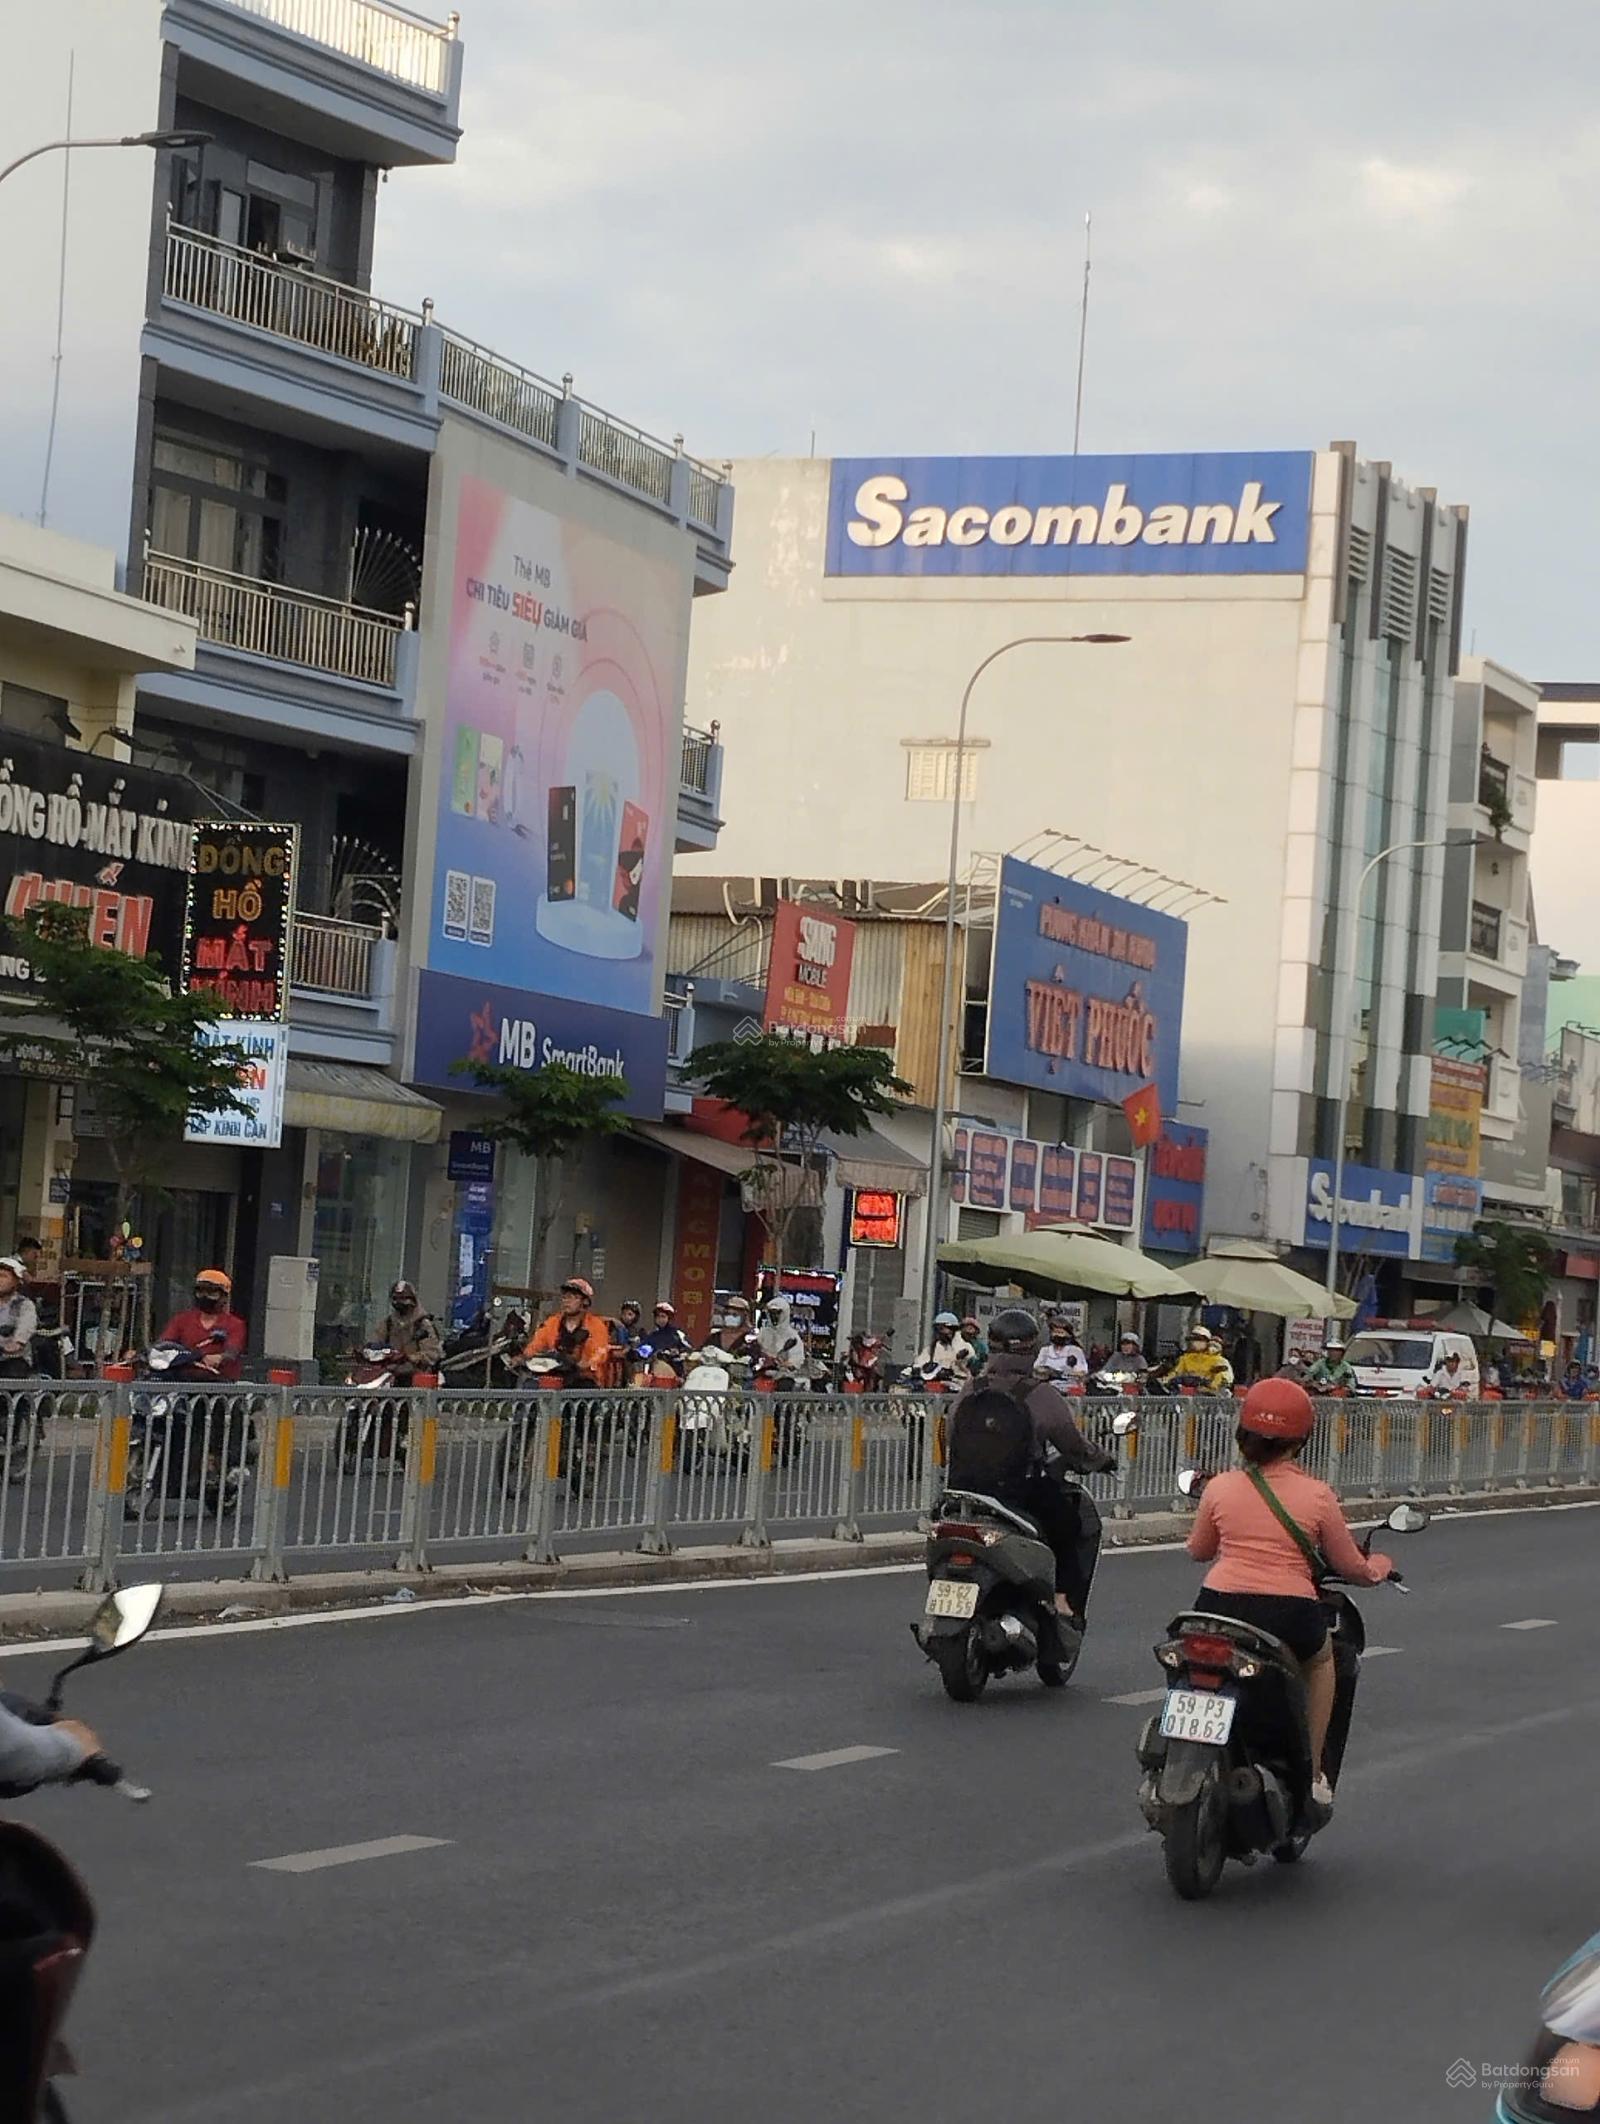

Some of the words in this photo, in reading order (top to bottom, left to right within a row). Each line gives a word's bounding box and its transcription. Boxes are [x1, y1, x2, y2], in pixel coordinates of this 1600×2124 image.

[846, 475, 1284, 546] Sacombank
[466, 577, 484, 602] CHI
[534, 563, 551, 589] MB
[212, 877, 262, 921] HỒ
[196, 923, 272, 972] MẮT
[1025, 963, 1080, 1074] VIỆT
[499, 1018, 536, 1069] MB
[541, 1037, 625, 1079] SmartBank
[470, 1141, 491, 1154] MB
